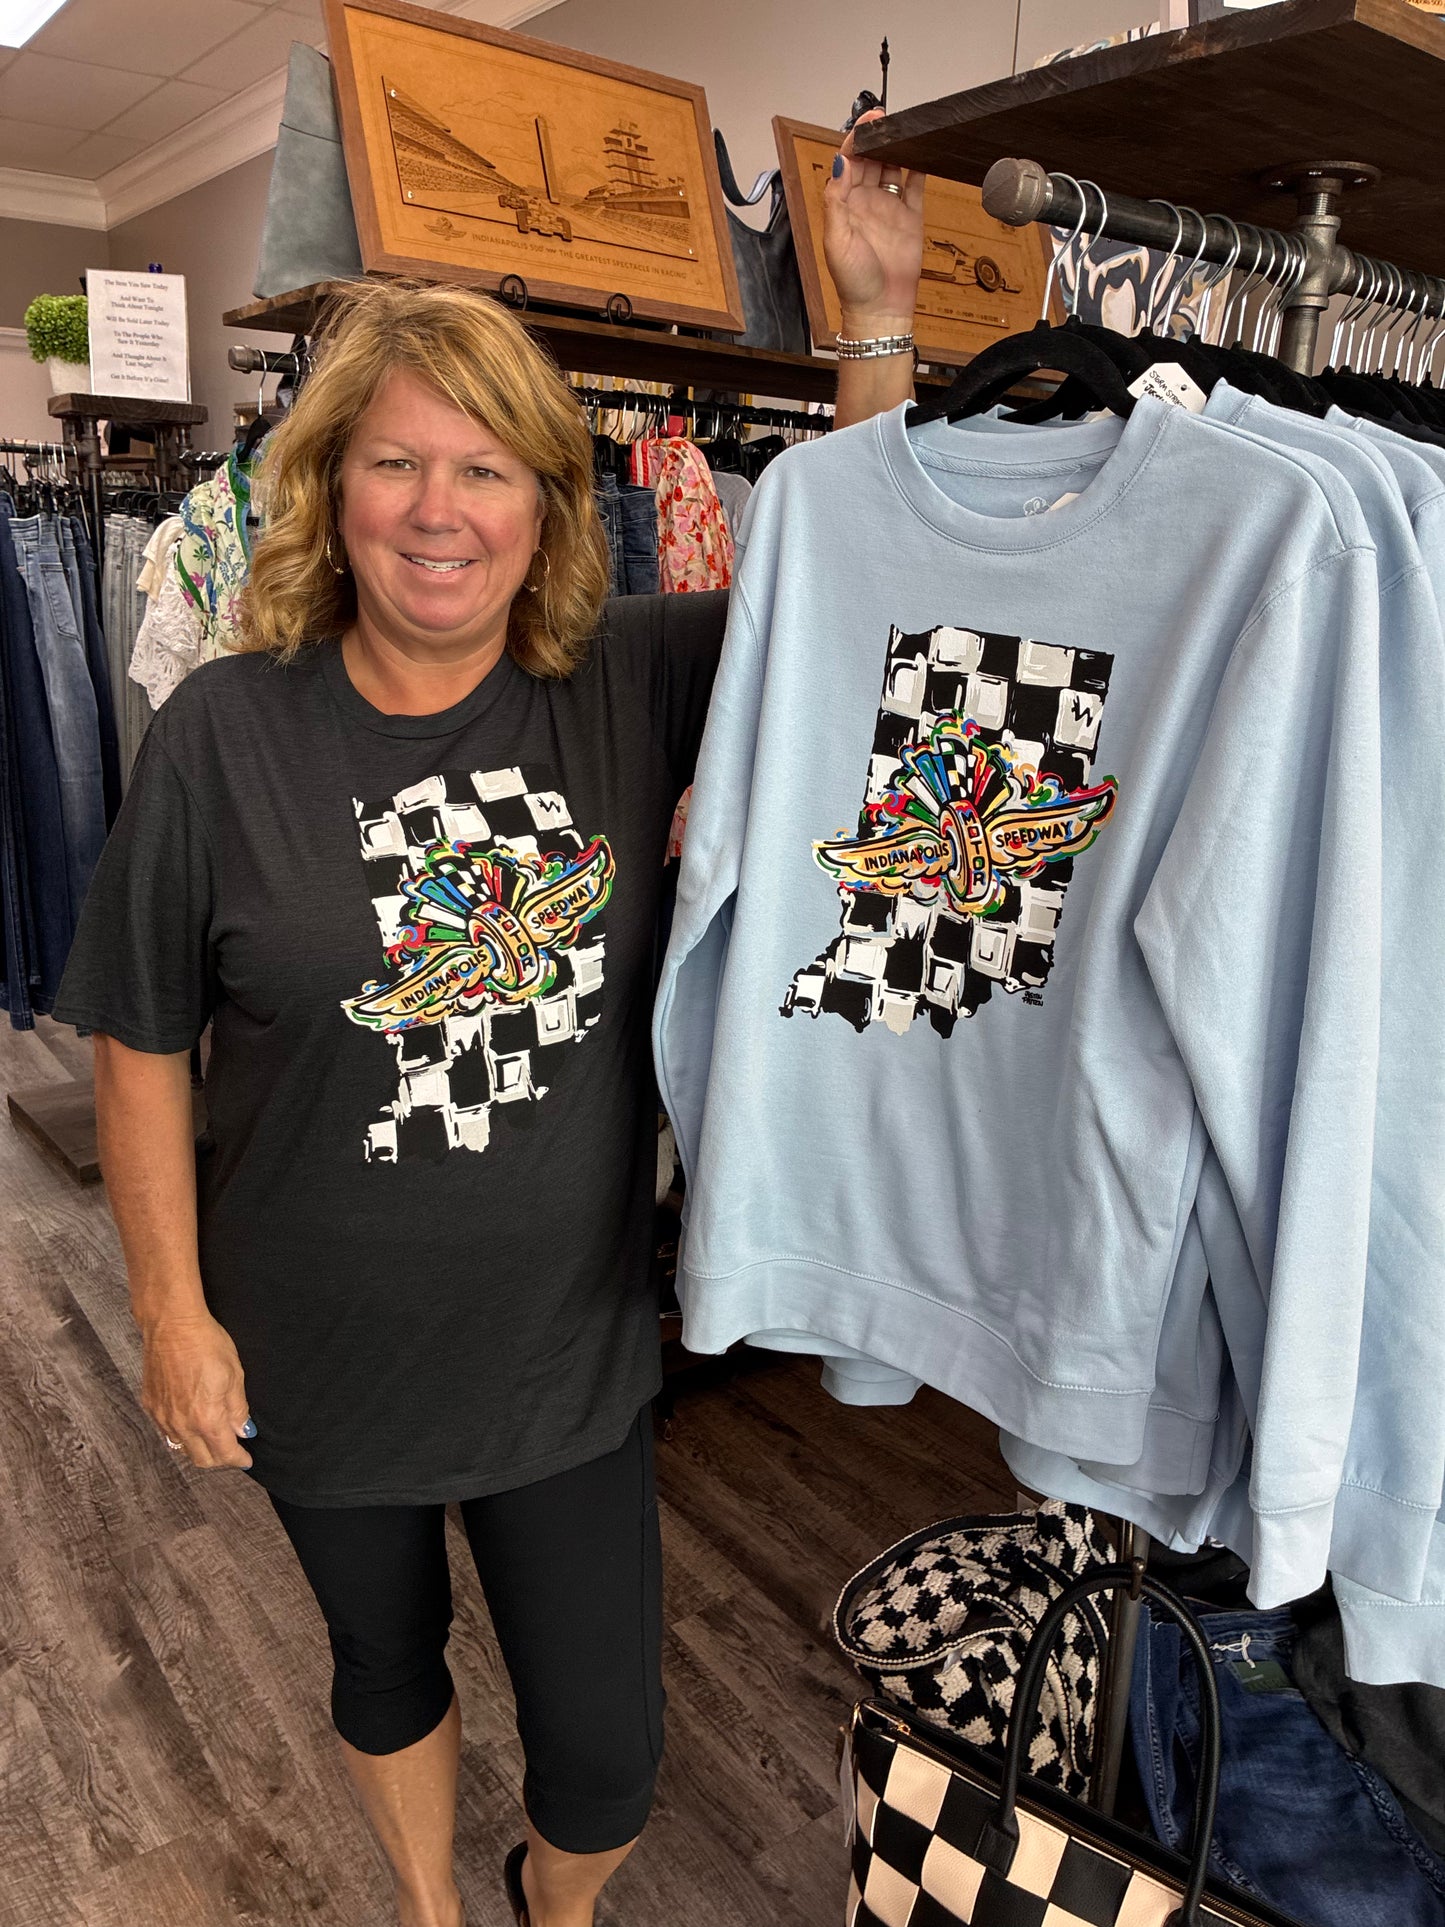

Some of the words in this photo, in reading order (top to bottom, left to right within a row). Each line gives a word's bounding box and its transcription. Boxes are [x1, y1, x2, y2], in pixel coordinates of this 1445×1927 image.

[559, 249, 574, 258] THE
[575, 252, 610, 265] GREATEST
[612, 259, 650, 273] SPECTACLE
[651, 266, 660, 274] IN
[661, 268, 687, 279] RACING
[152, 283, 168, 291] Today
[144, 304, 164, 312] Tonight
[132, 332, 150, 340] People
[153, 319, 170, 327] Today
[135, 340, 160, 348] Yesterday
[995, 820, 1072, 849] SPEEDWAY
[864, 843, 951, 871] INDIANAPOLIS
[963, 812, 986, 887] MOTOR
[530, 880, 593, 929] SPEEDWAY
[489, 908, 535, 972] MOTOR
[401, 949, 488, 1009] INDIANAPOLIS
